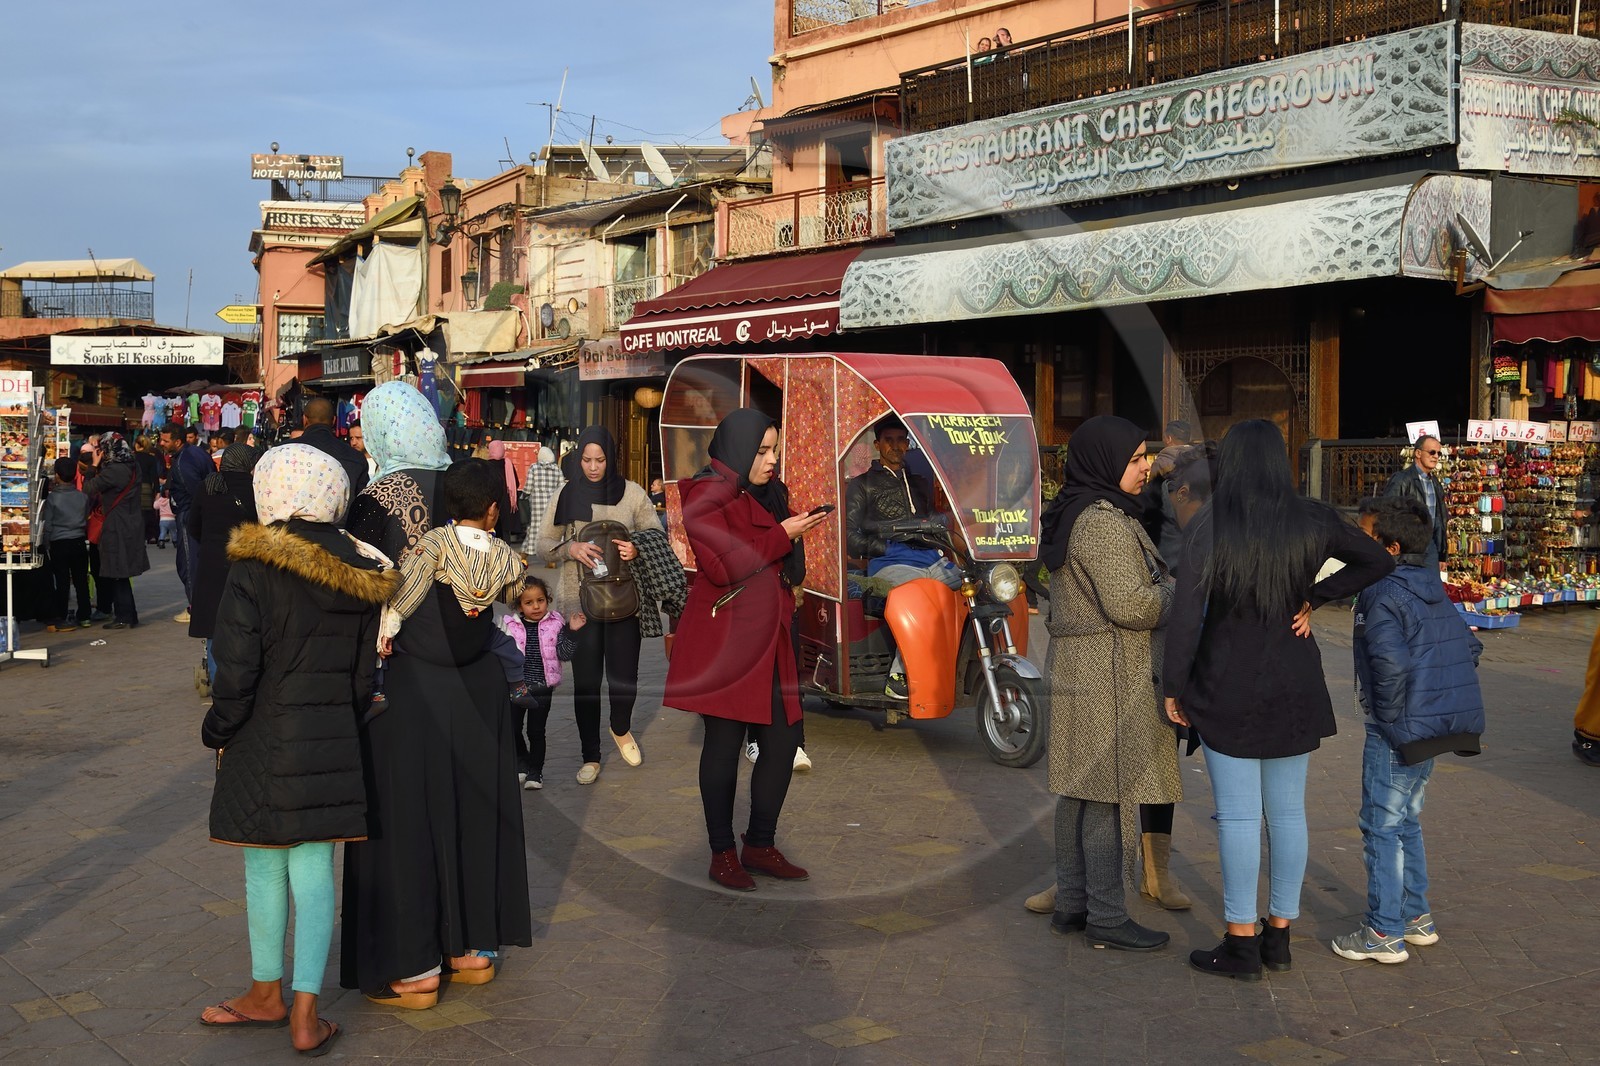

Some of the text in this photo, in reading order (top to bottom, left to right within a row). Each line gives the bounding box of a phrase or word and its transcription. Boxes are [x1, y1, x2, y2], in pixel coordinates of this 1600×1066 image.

[1465, 77, 1539, 121] RESTAURANT
[924, 53, 1377, 177] RESTAURANT CHEZ CHEGROUNI
[1173, 122, 1276, 173] مطعم
[310, 156, 342, 167] فندق
[1117, 146, 1167, 174] عند
[253, 169, 284, 178] HOTEL
[1001, 148, 1109, 209] الشكروني
[267, 212, 319, 225] HOTEL
[84, 337, 195, 353] سوق القصابين
[624, 326, 722, 351] CAFE MONTREAL
[83, 352, 196, 364] Souk El Kessabine
[1, 379, 30, 393] DH
[927, 414, 1002, 429] MARRAKECH
[1475, 427, 1483, 439] 5
[1501, 426, 1509, 437] 5
[1525, 428, 1536, 439] 5
